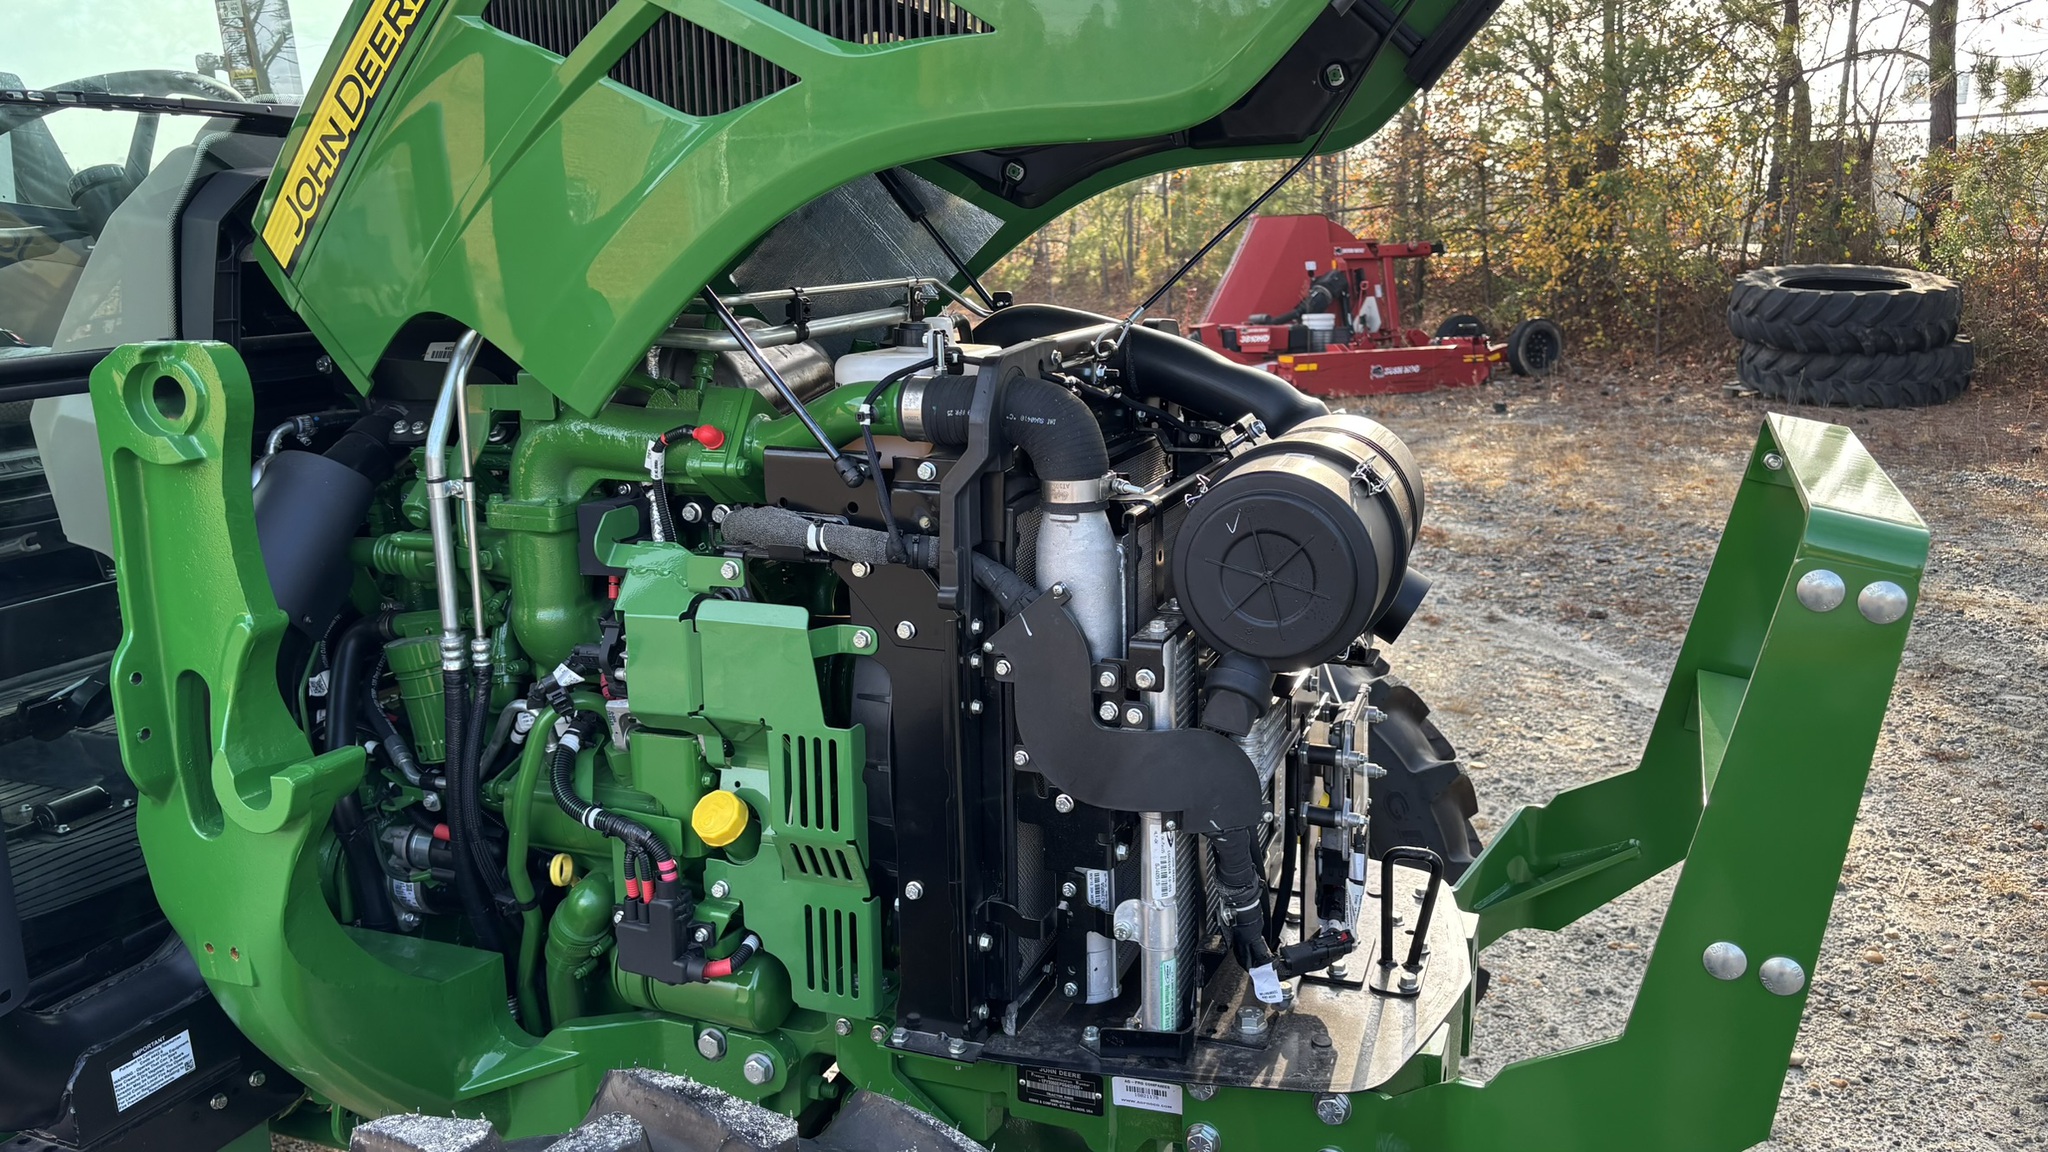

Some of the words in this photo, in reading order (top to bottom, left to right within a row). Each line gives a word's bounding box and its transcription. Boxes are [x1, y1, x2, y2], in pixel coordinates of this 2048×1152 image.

[286, 116, 347, 237] JOHN
[113, 1071, 132, 1084] WARNING
[169, 1040, 188, 1053] Equipment
[132, 1034, 166, 1057] IMPORTANT
[1058, 1070, 1081, 1078] DEERE
